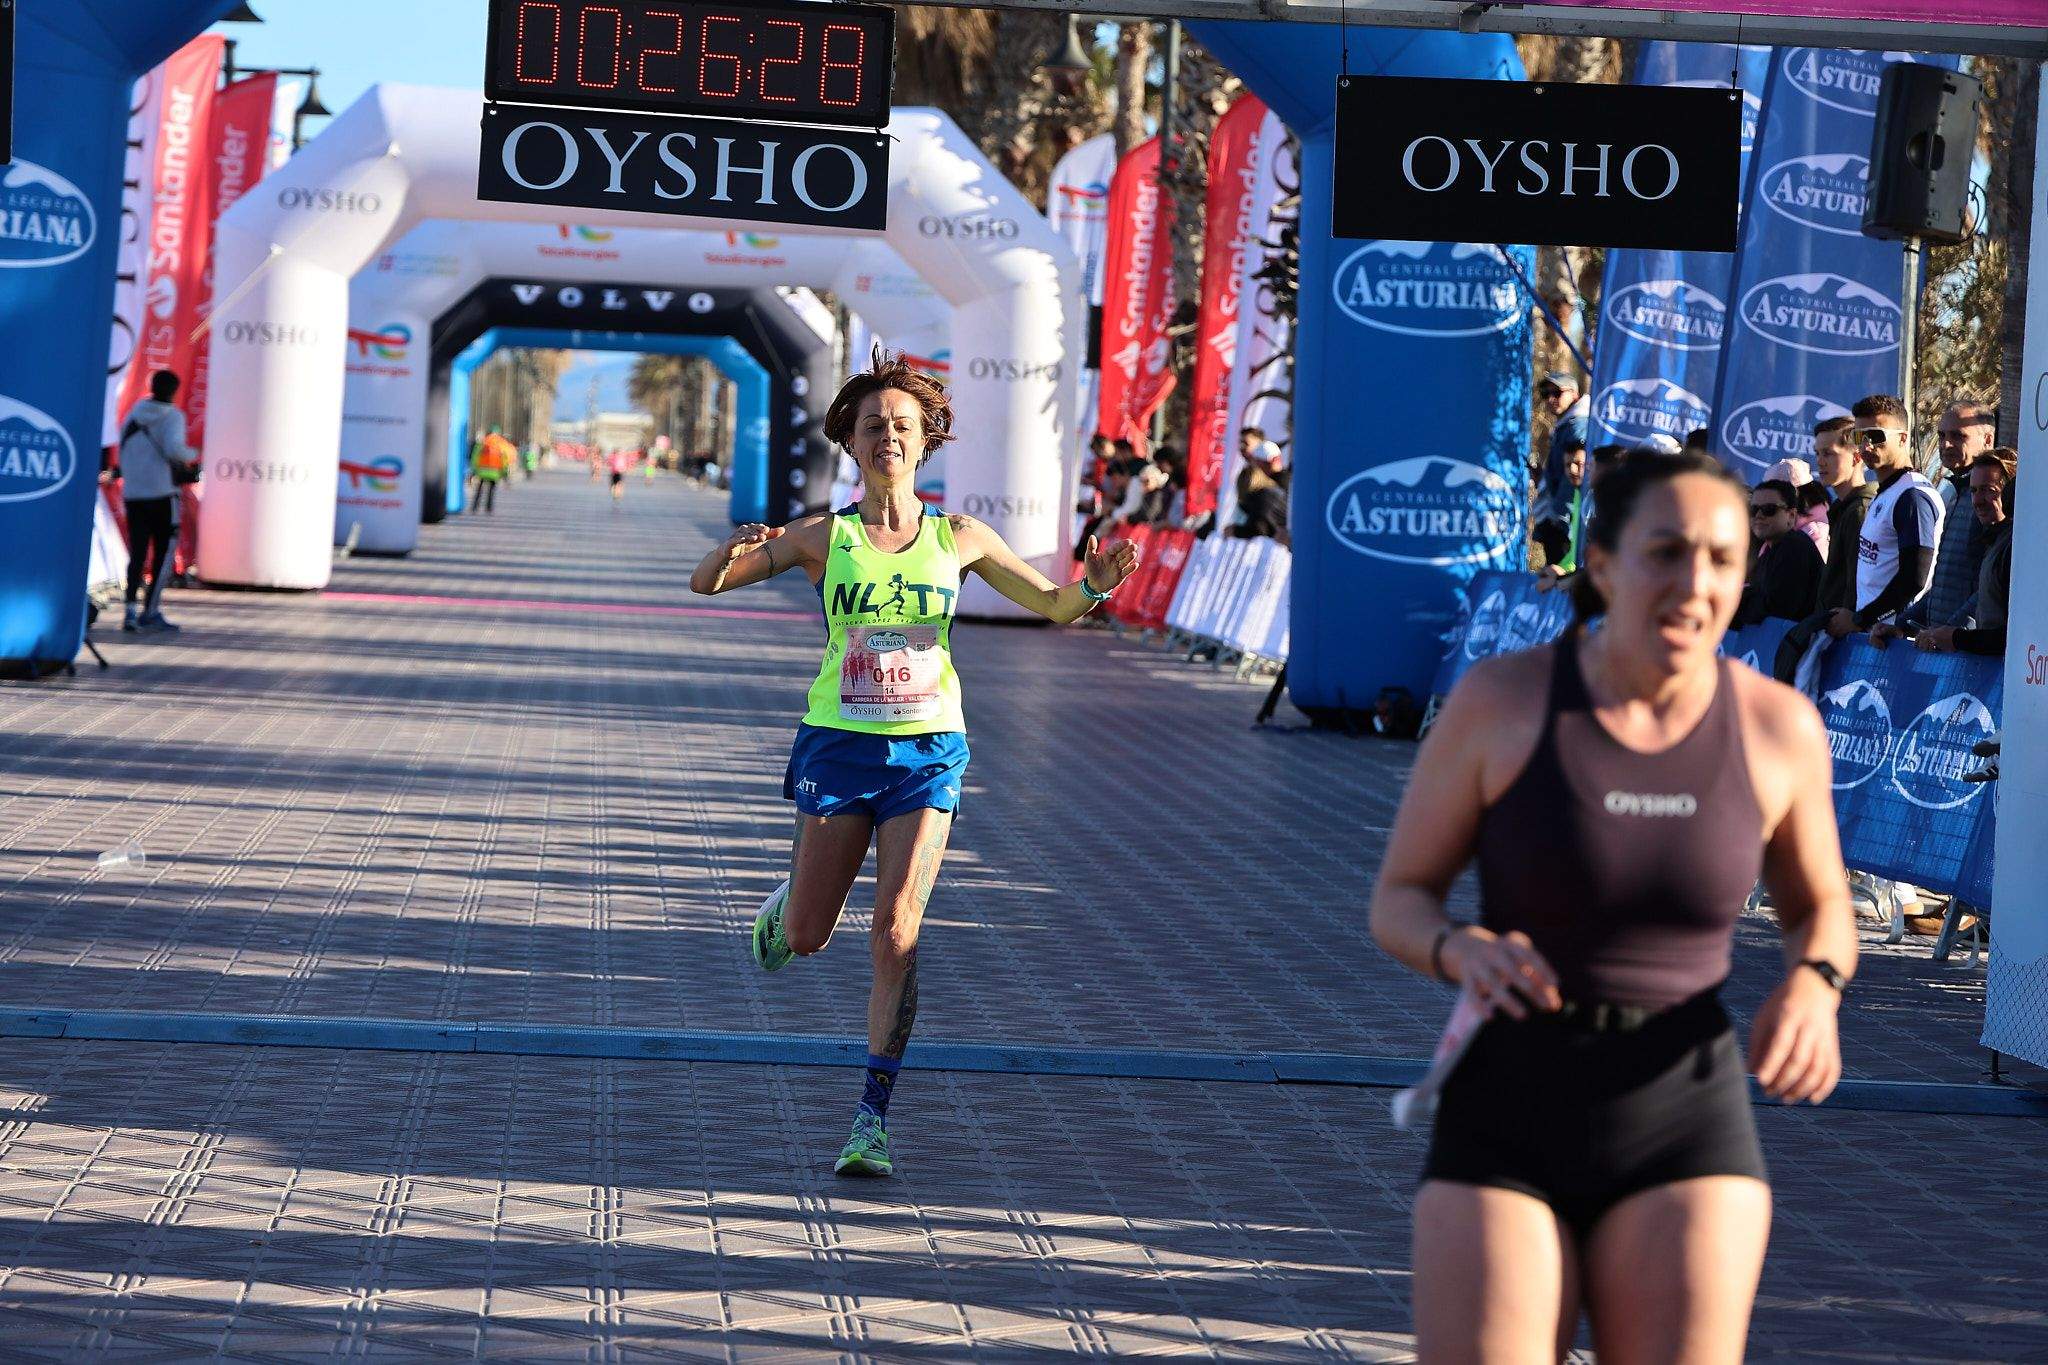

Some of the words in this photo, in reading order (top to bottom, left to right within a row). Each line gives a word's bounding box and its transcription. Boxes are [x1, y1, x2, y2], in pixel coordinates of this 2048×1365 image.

[514, 2, 866, 107] 00:26:28
[1795, 51, 1883, 97] ASTUR
[149, 84, 194, 271] Santander
[501, 121, 868, 212] OYSHO
[1402, 134, 1680, 201] OYSHO
[277, 186, 382, 215] OYSHO
[1771, 171, 1866, 217] ASTURI
[918, 215, 1020, 240] OYSHO
[1119, 178, 1160, 338] Santander
[510, 284, 716, 314] VOLVO
[1346, 264, 1518, 312] ASTURIAN
[1749, 291, 1896, 343] ASTURIANA
[1731, 415, 1816, 455] ASTUR
[1339, 491, 1508, 538] ASTURIAN
[872, 666, 912, 684] 016
[884, 687, 895, 695] 14
[851, 707, 882, 716] OYSHO
